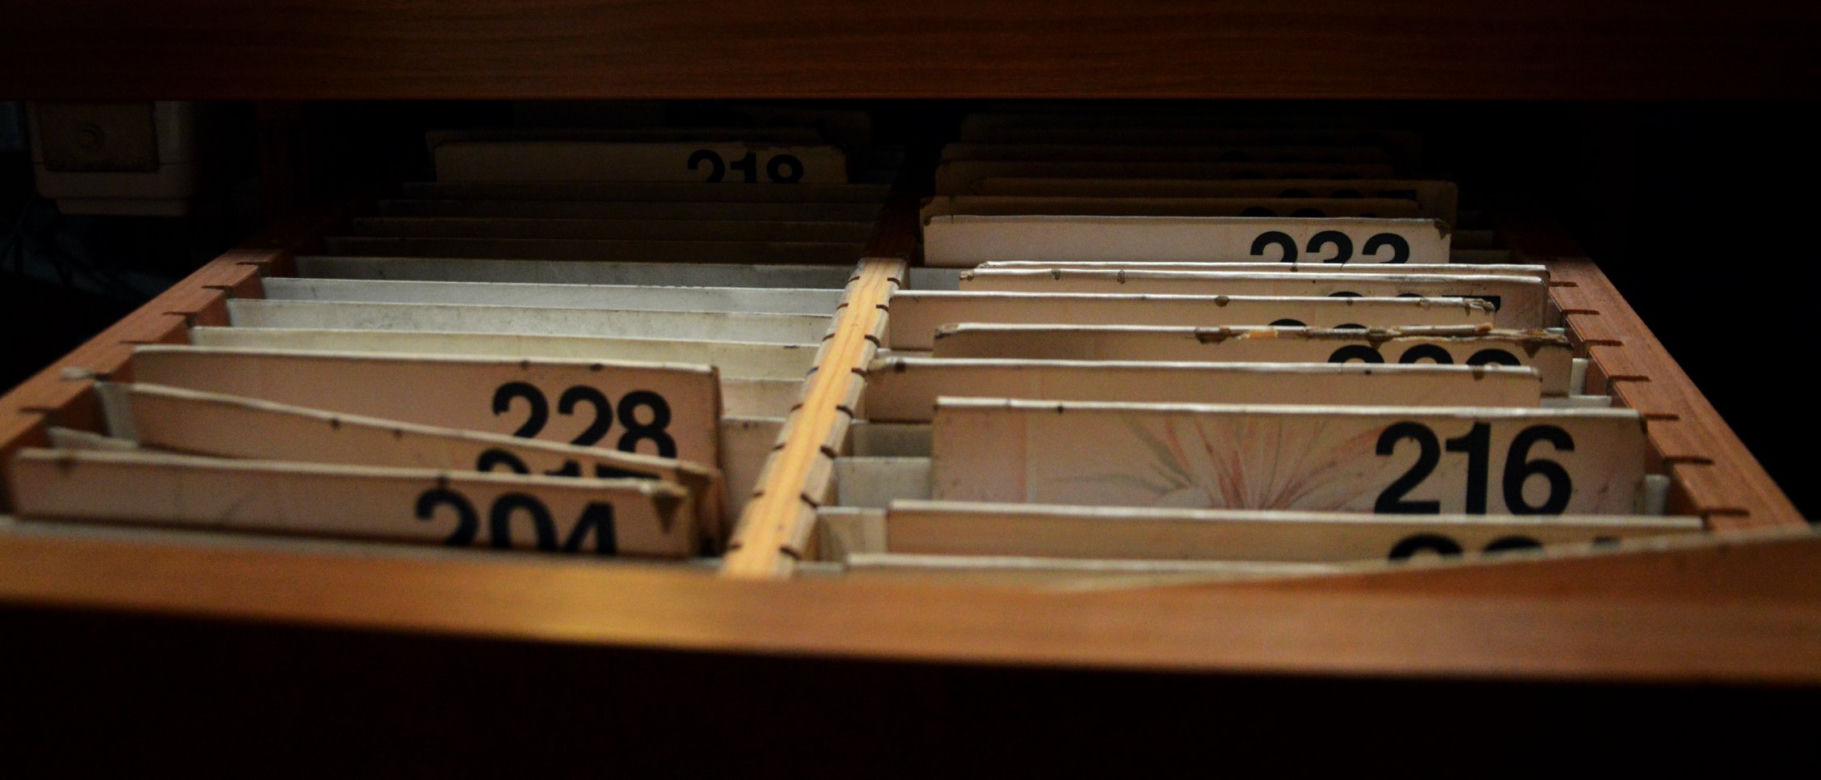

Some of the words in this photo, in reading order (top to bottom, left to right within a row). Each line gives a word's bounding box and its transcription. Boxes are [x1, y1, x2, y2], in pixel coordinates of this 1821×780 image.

[493, 382, 677, 458] 228
[1374, 421, 1575, 515] 216
[416, 488, 616, 554] 204
